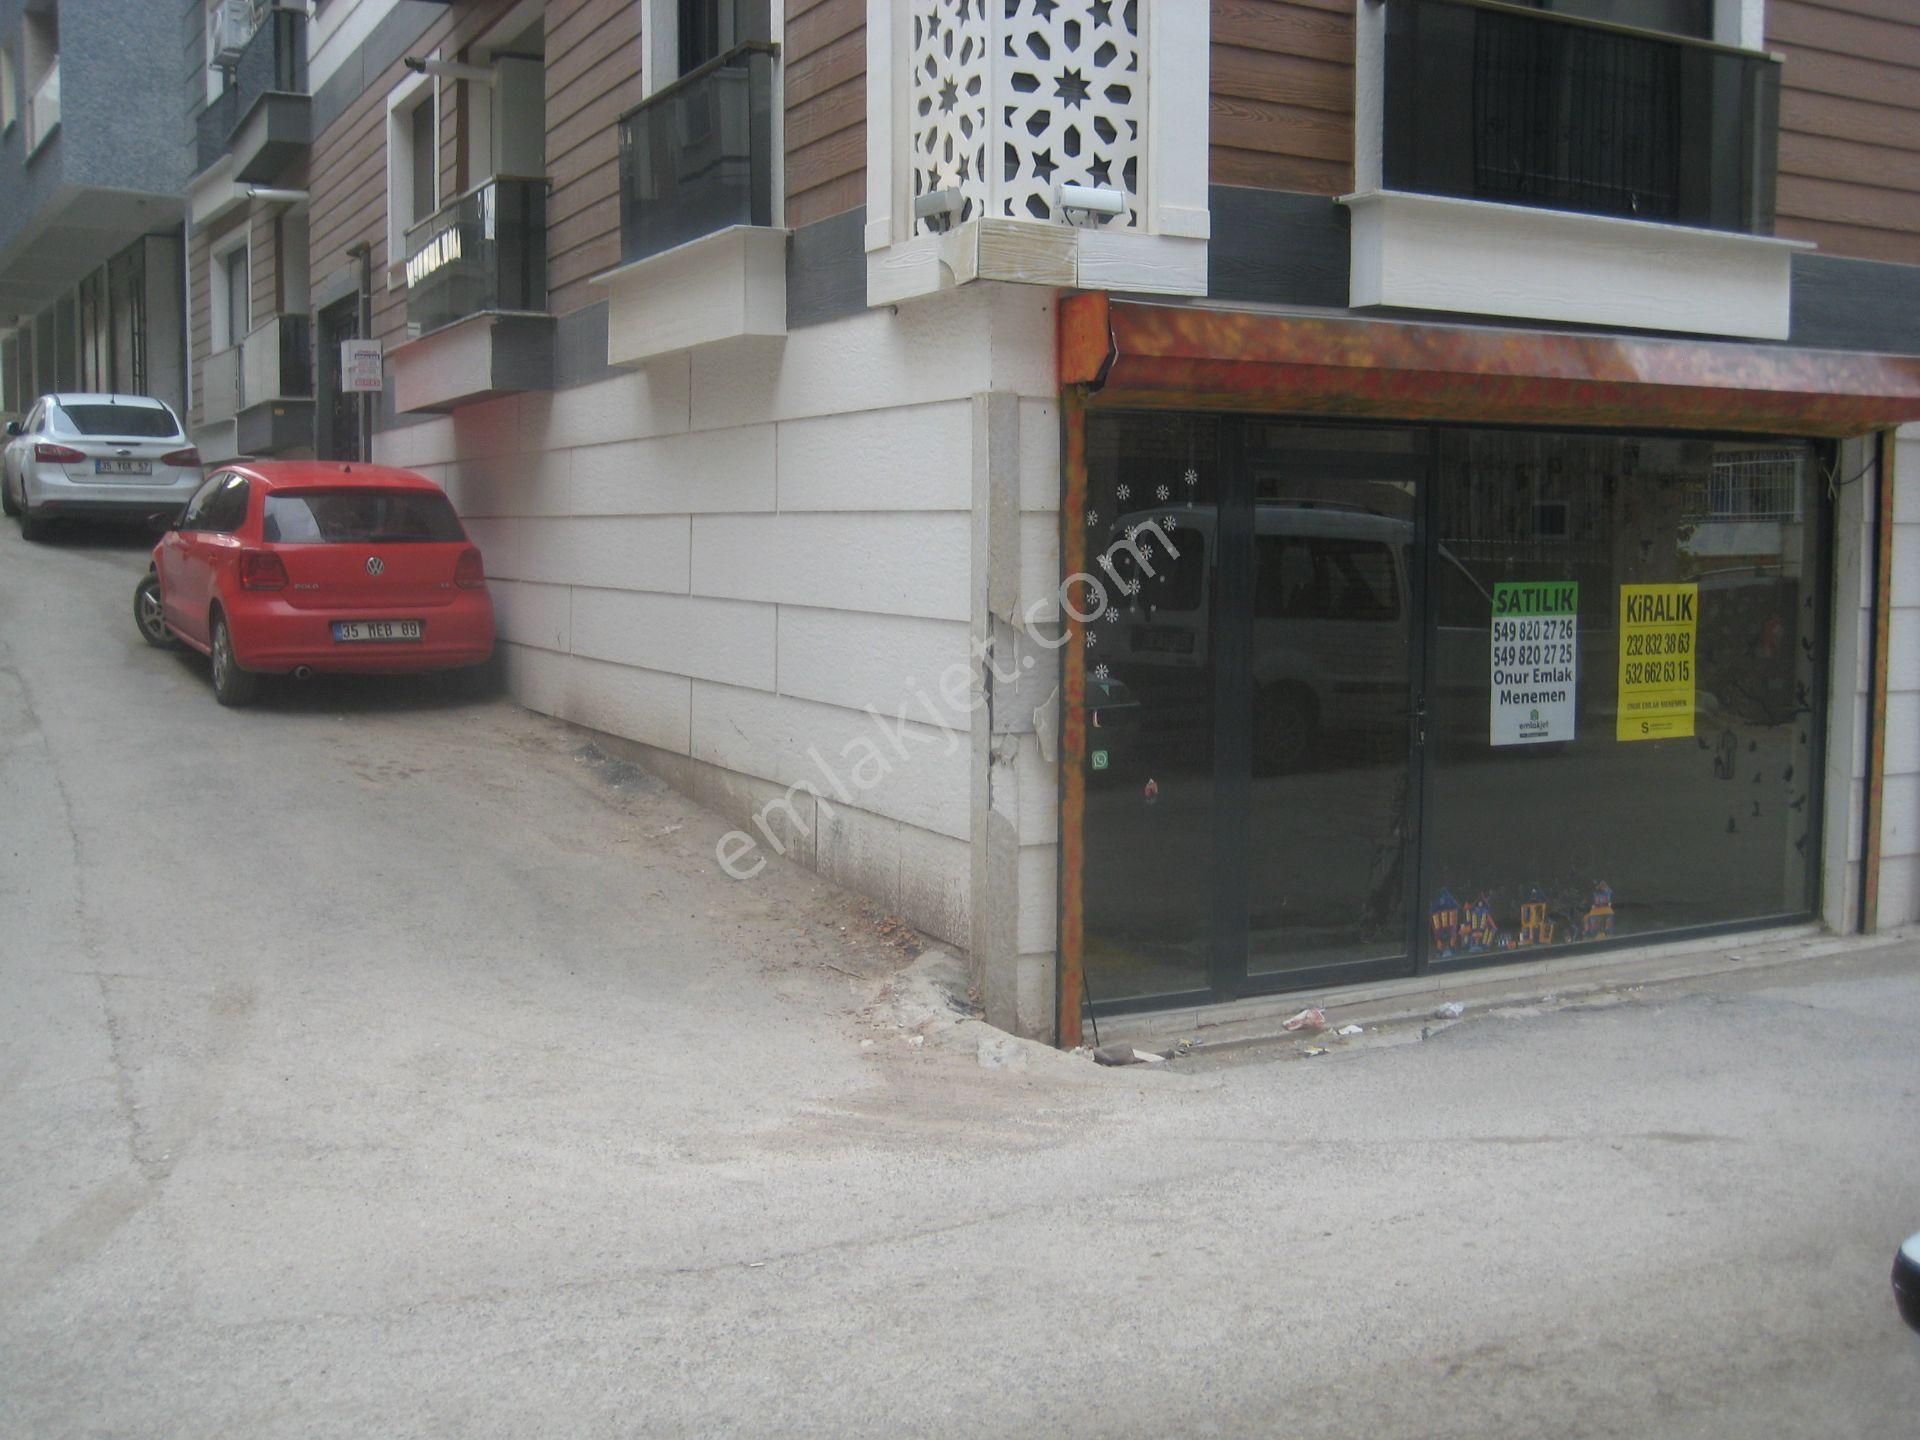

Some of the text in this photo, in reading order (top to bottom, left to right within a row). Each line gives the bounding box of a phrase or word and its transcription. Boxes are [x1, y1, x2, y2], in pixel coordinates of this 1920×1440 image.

[1496, 588, 1574, 613] SATILIK
[342, 623, 359, 638] 35
[1494, 619, 1573, 642] 549 820 27 26
[1494, 643, 1572, 667] 549 820 27 25
[1626, 632, 1690, 656] 232 832 38 63
[1494, 667, 1572, 685] Onur Emlak
[1625, 660, 1689, 685] 532 662 63 15
[1500, 689, 1566, 705] Menemen
[1519, 720, 1549, 730] emlakjet
